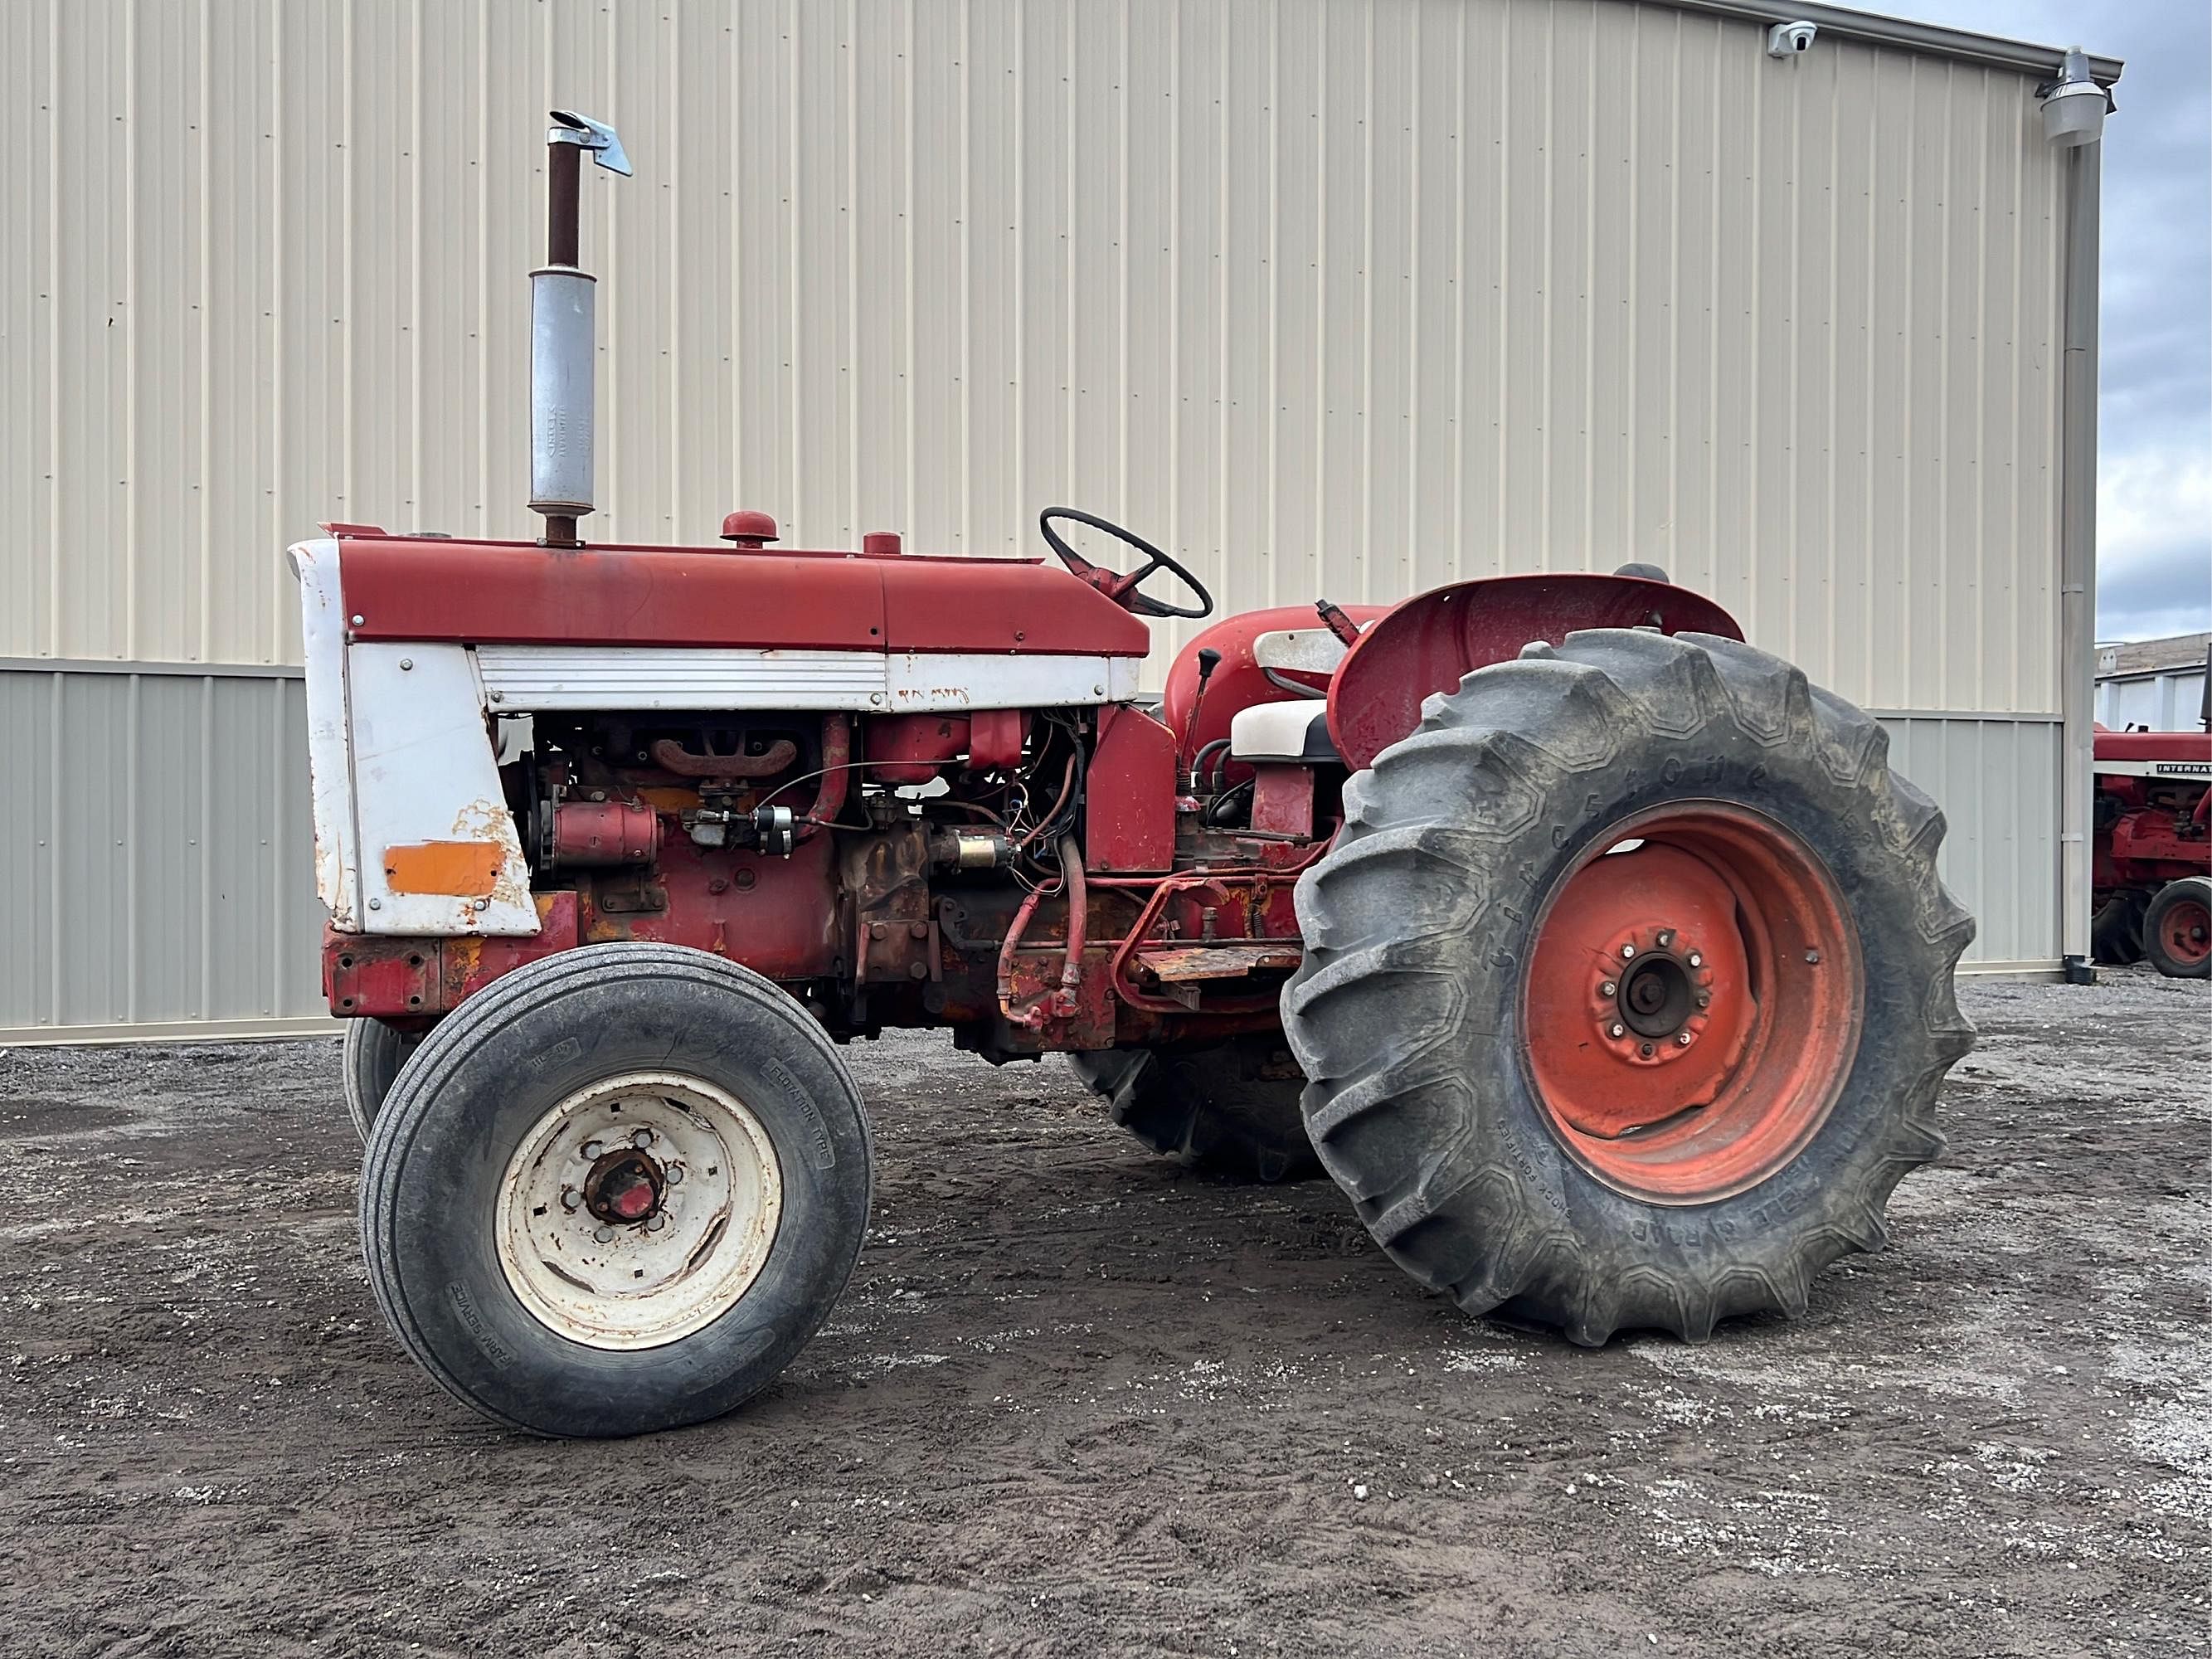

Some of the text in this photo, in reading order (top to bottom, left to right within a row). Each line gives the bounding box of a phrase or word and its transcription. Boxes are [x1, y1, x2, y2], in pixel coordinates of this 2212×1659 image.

[770, 1065, 830, 1160] FLOTATION TYPE
[1497, 1117, 1573, 1219] SHOCK FORTIFIED
[451, 1283, 512, 1368] FARM SERVICE
